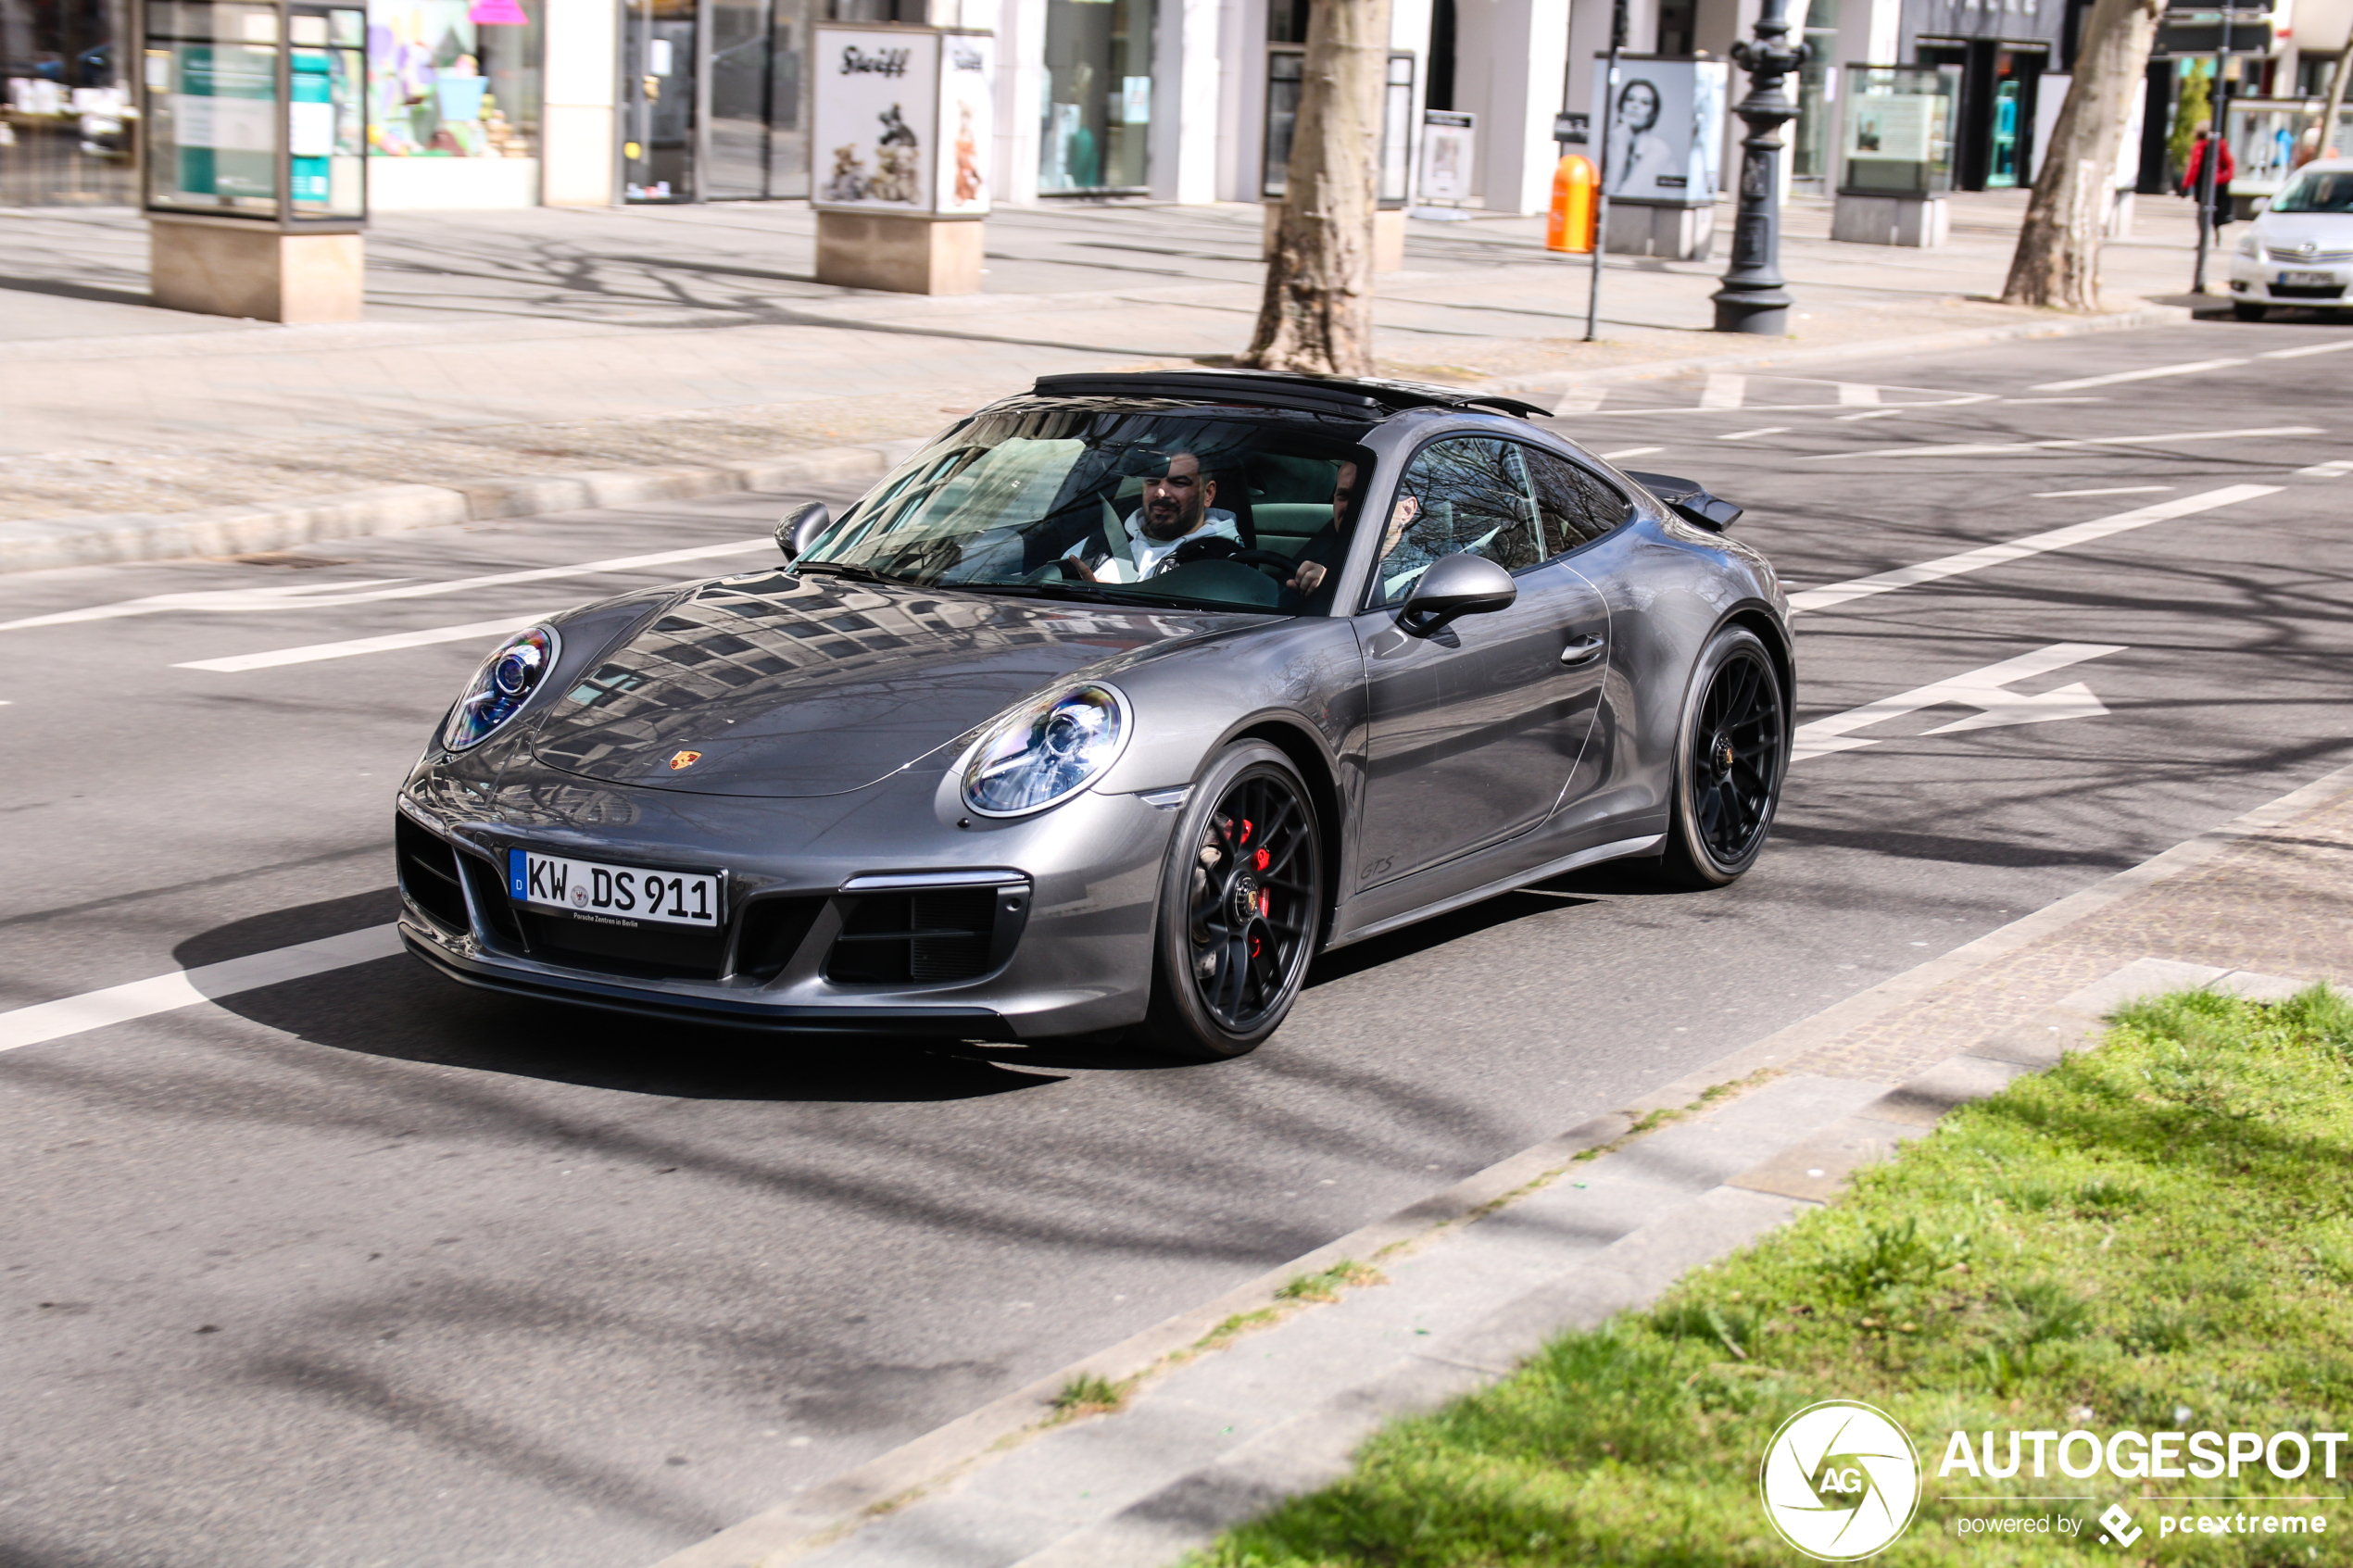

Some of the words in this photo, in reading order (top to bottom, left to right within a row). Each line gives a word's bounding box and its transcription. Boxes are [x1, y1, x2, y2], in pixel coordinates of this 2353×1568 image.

[1361, 855, 1394, 879] GTS
[515, 879, 523, 891] D
[528, 857, 568, 902] KW
[591, 868, 636, 911] DS
[644, 875, 712, 921] 911
[573, 912, 594, 921] Porsche
[595, 915, 615, 924] Zentren
